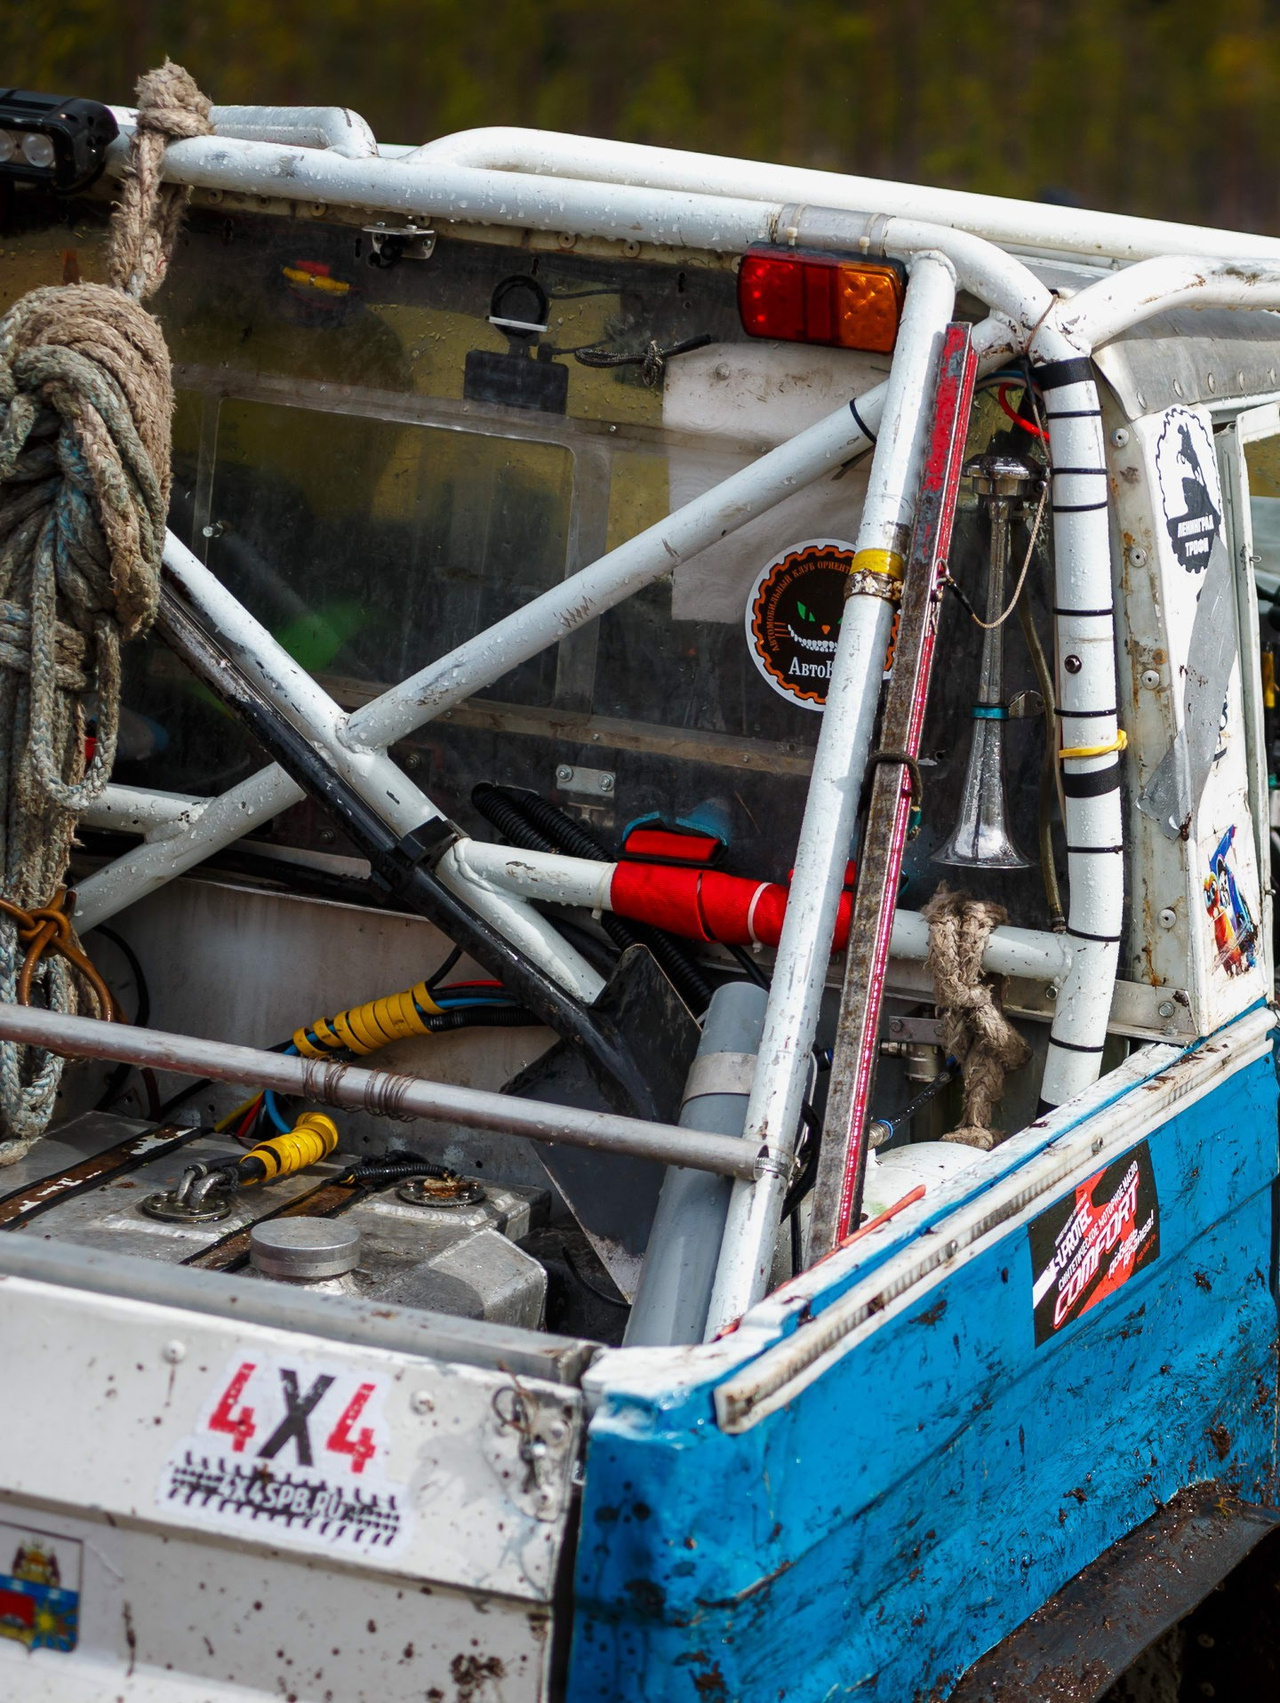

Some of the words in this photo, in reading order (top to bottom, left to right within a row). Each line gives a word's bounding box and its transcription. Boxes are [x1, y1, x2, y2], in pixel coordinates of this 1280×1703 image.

[766, 574, 793, 652] АВТОМОБИЛЬНЫЙ
[791, 562, 816, 578] КЛУБ
[817, 560, 851, 575] ОРИЕНТ
[1053, 1172, 1140, 1328] COMFORT
